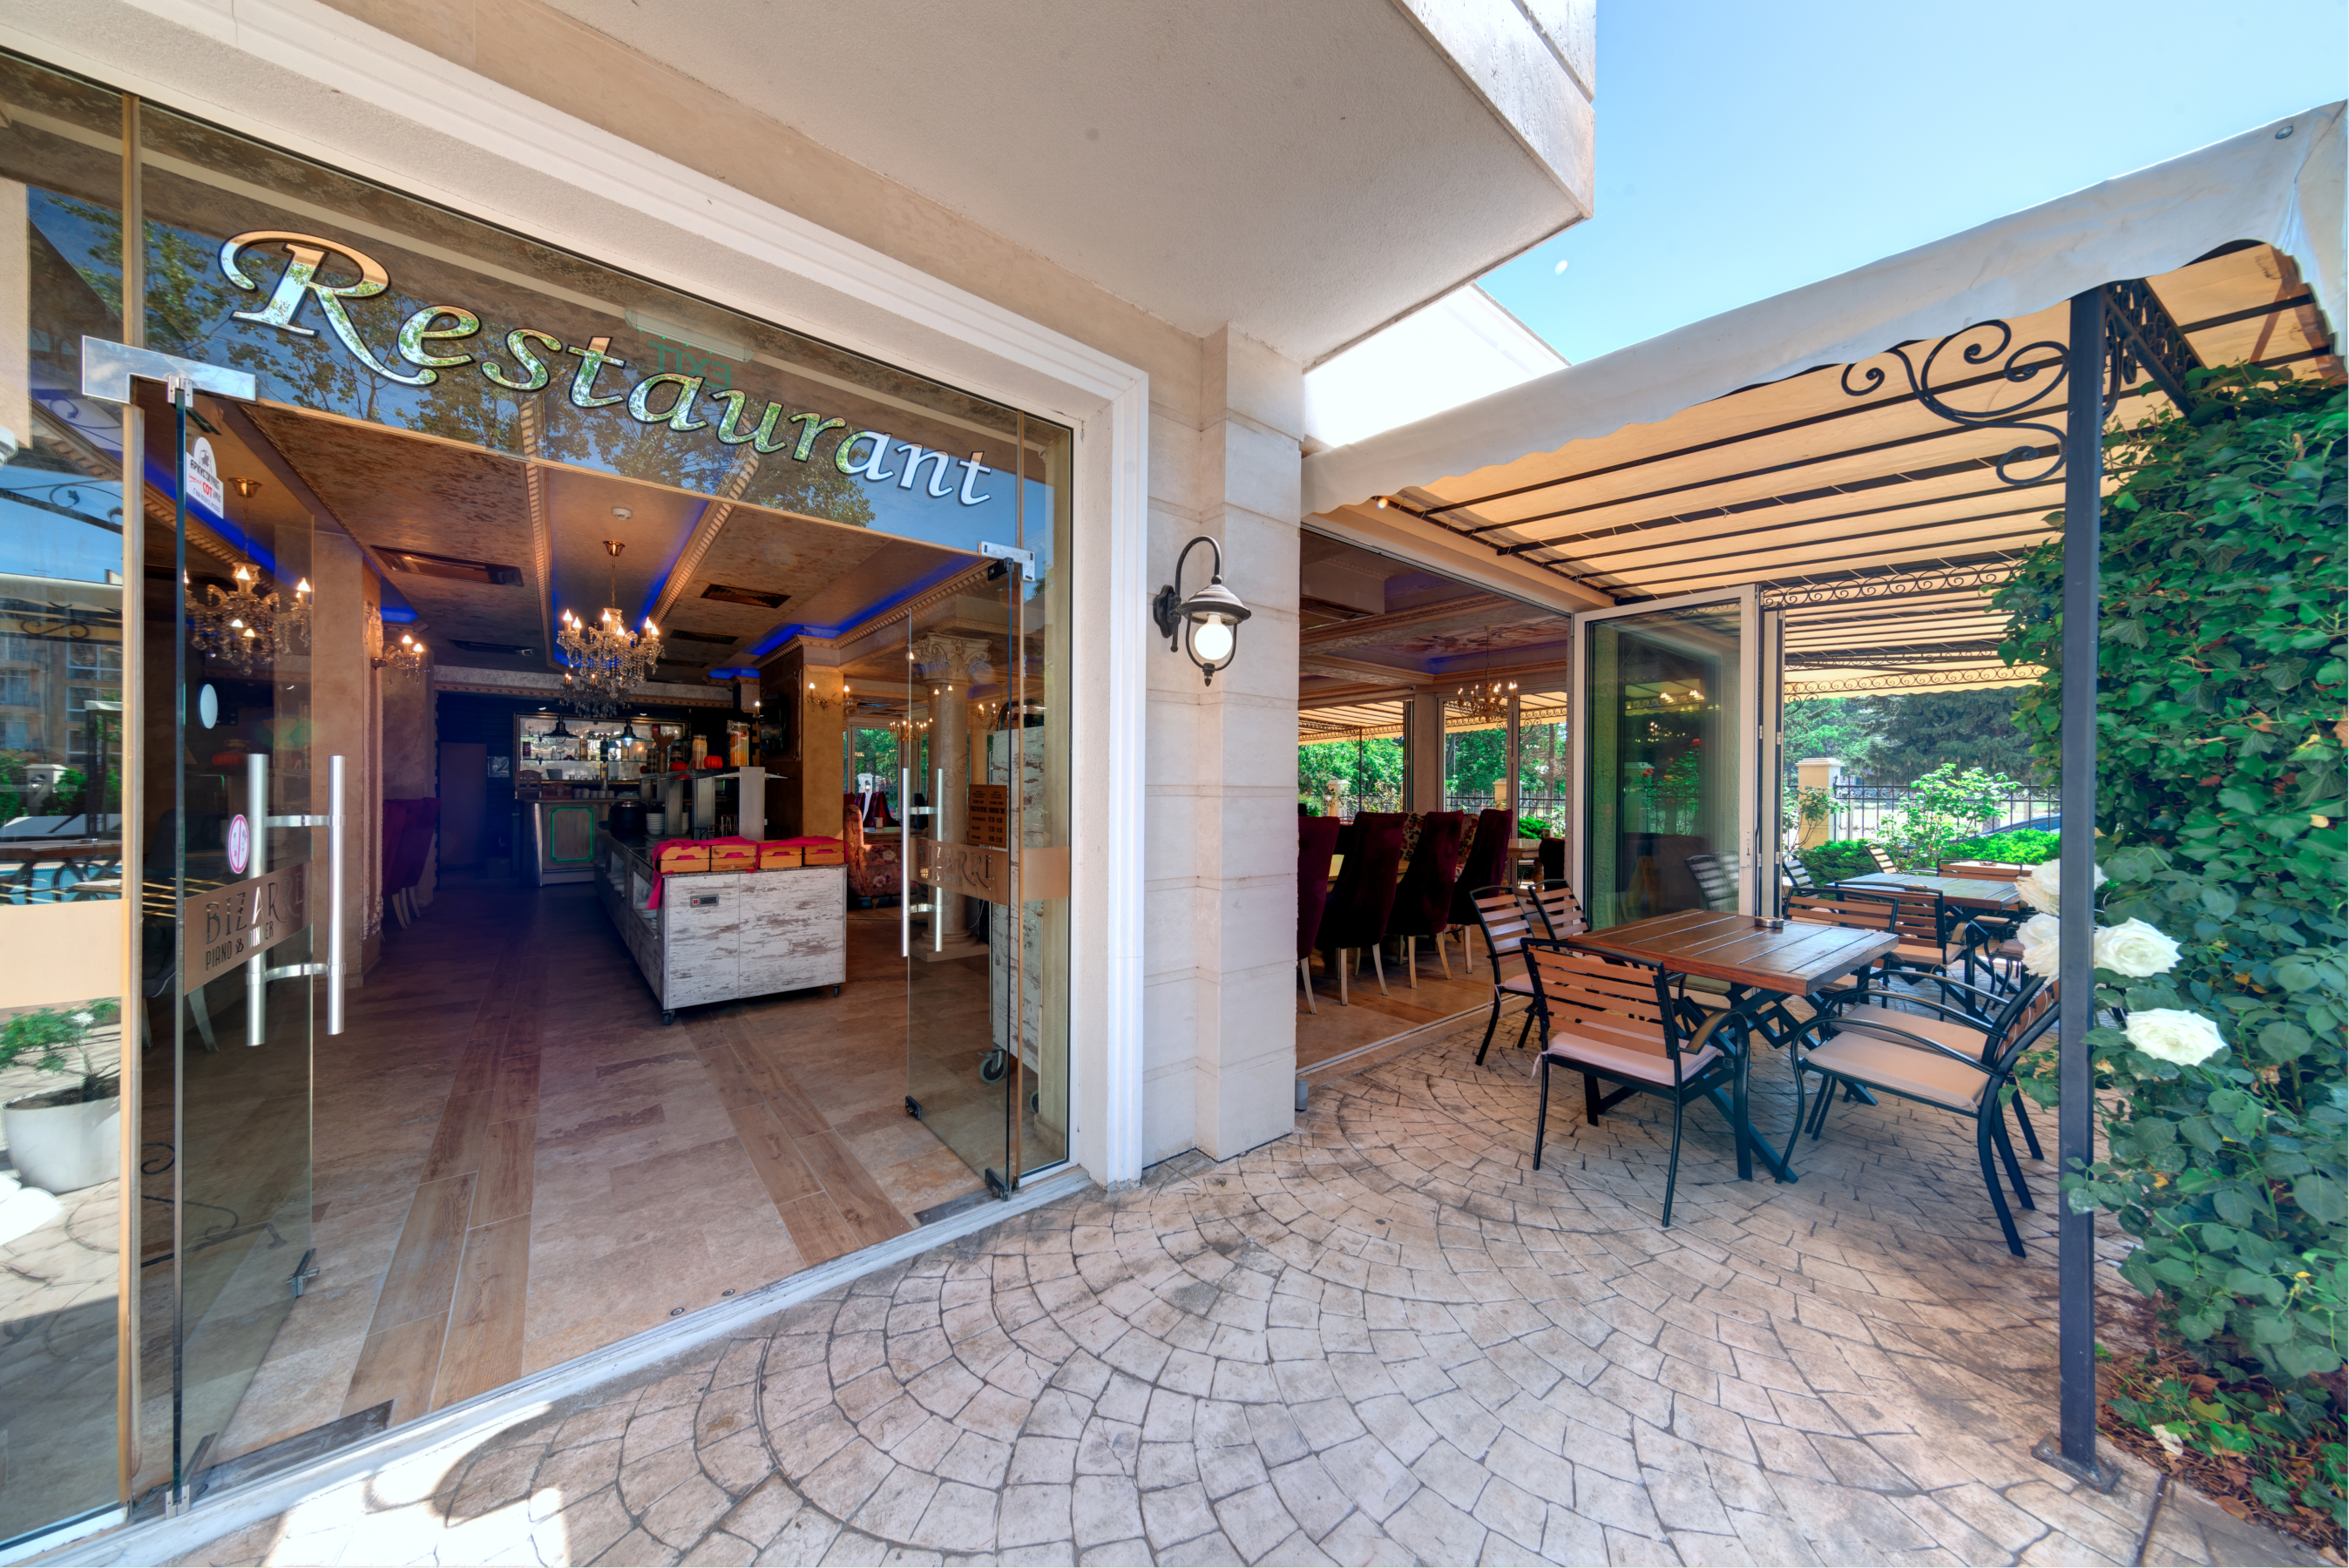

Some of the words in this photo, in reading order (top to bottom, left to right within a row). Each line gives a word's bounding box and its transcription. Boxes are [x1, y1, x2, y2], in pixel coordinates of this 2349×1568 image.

[219, 229, 992, 505] Restaurant
[918, 844, 994, 890] BIZARRE
[206, 873, 303, 945] BIZARRE
[206, 941, 232, 971] PIANO
